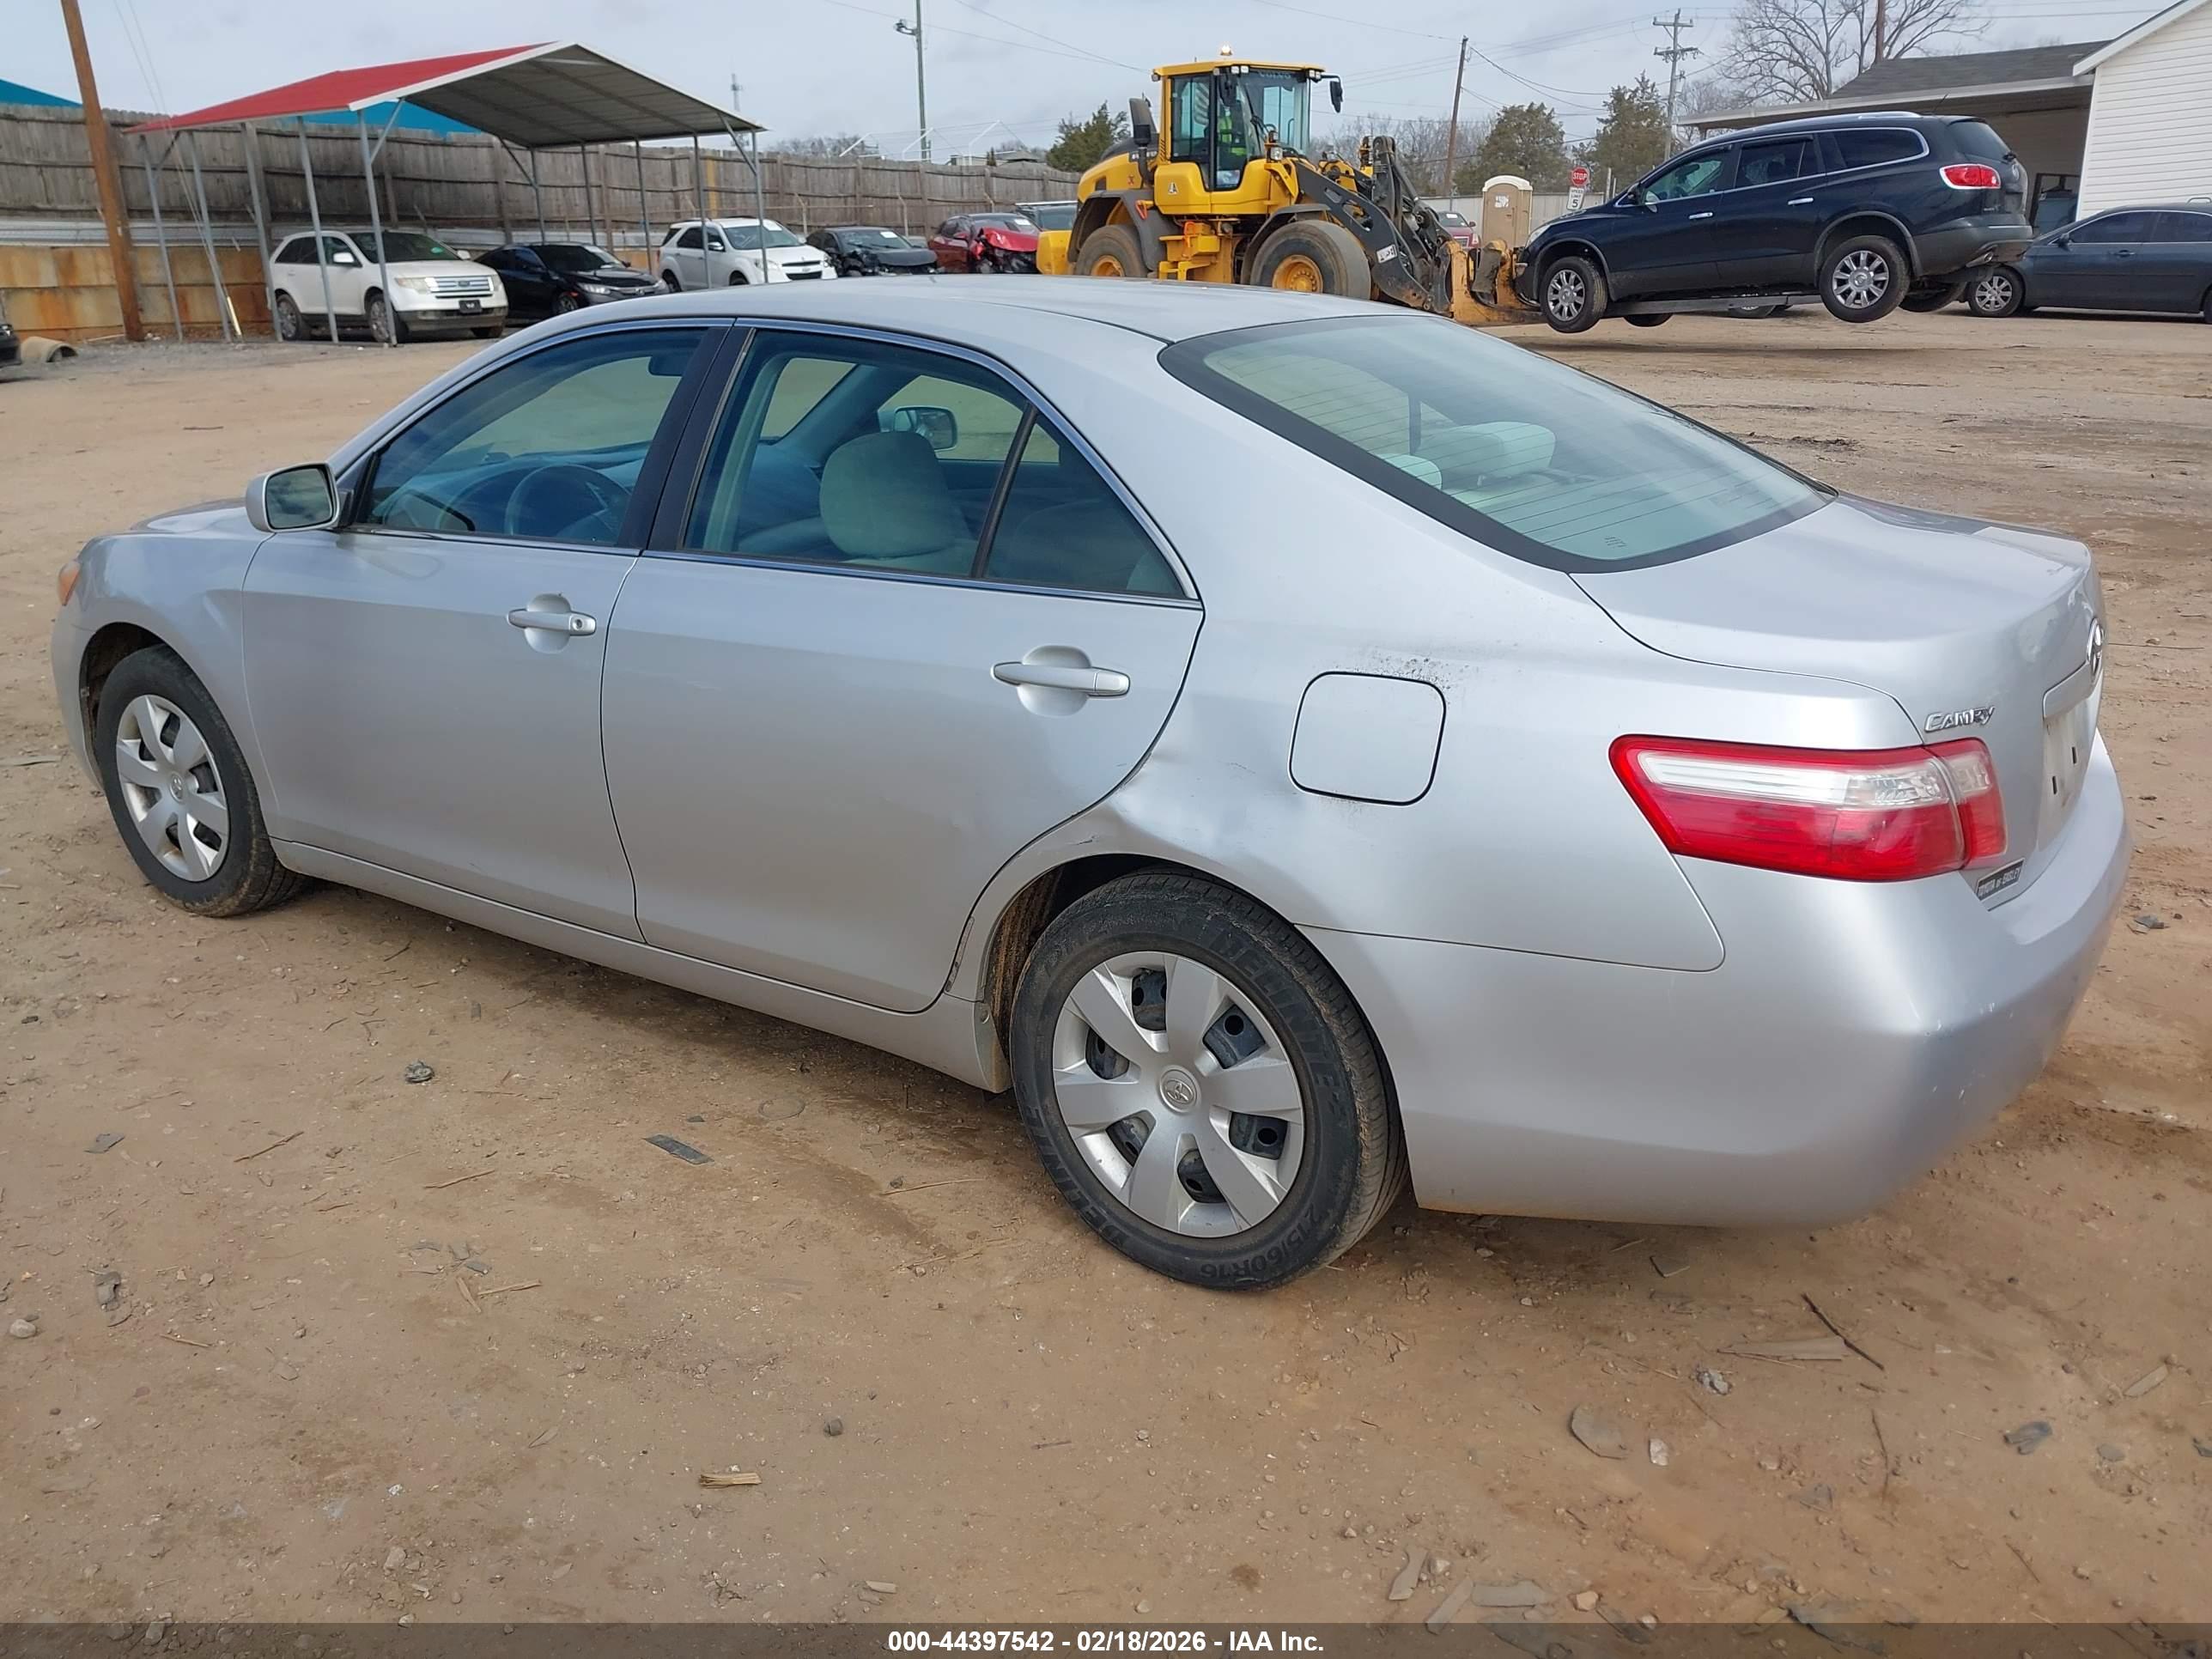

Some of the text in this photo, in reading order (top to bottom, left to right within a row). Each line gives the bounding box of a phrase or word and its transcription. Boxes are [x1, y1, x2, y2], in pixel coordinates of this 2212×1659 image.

[1572, 172, 1588, 180] STOP
[1571, 199, 1579, 208] 5
[1924, 705, 1996, 732] CAMRY
[1978, 878, 1996, 897] TOYOTA
[2002, 867, 2021, 884] EASLEY
[1025, 1105, 1130, 1247] DELINTE
[1200, 1203, 1322, 1278] 215/60R16
